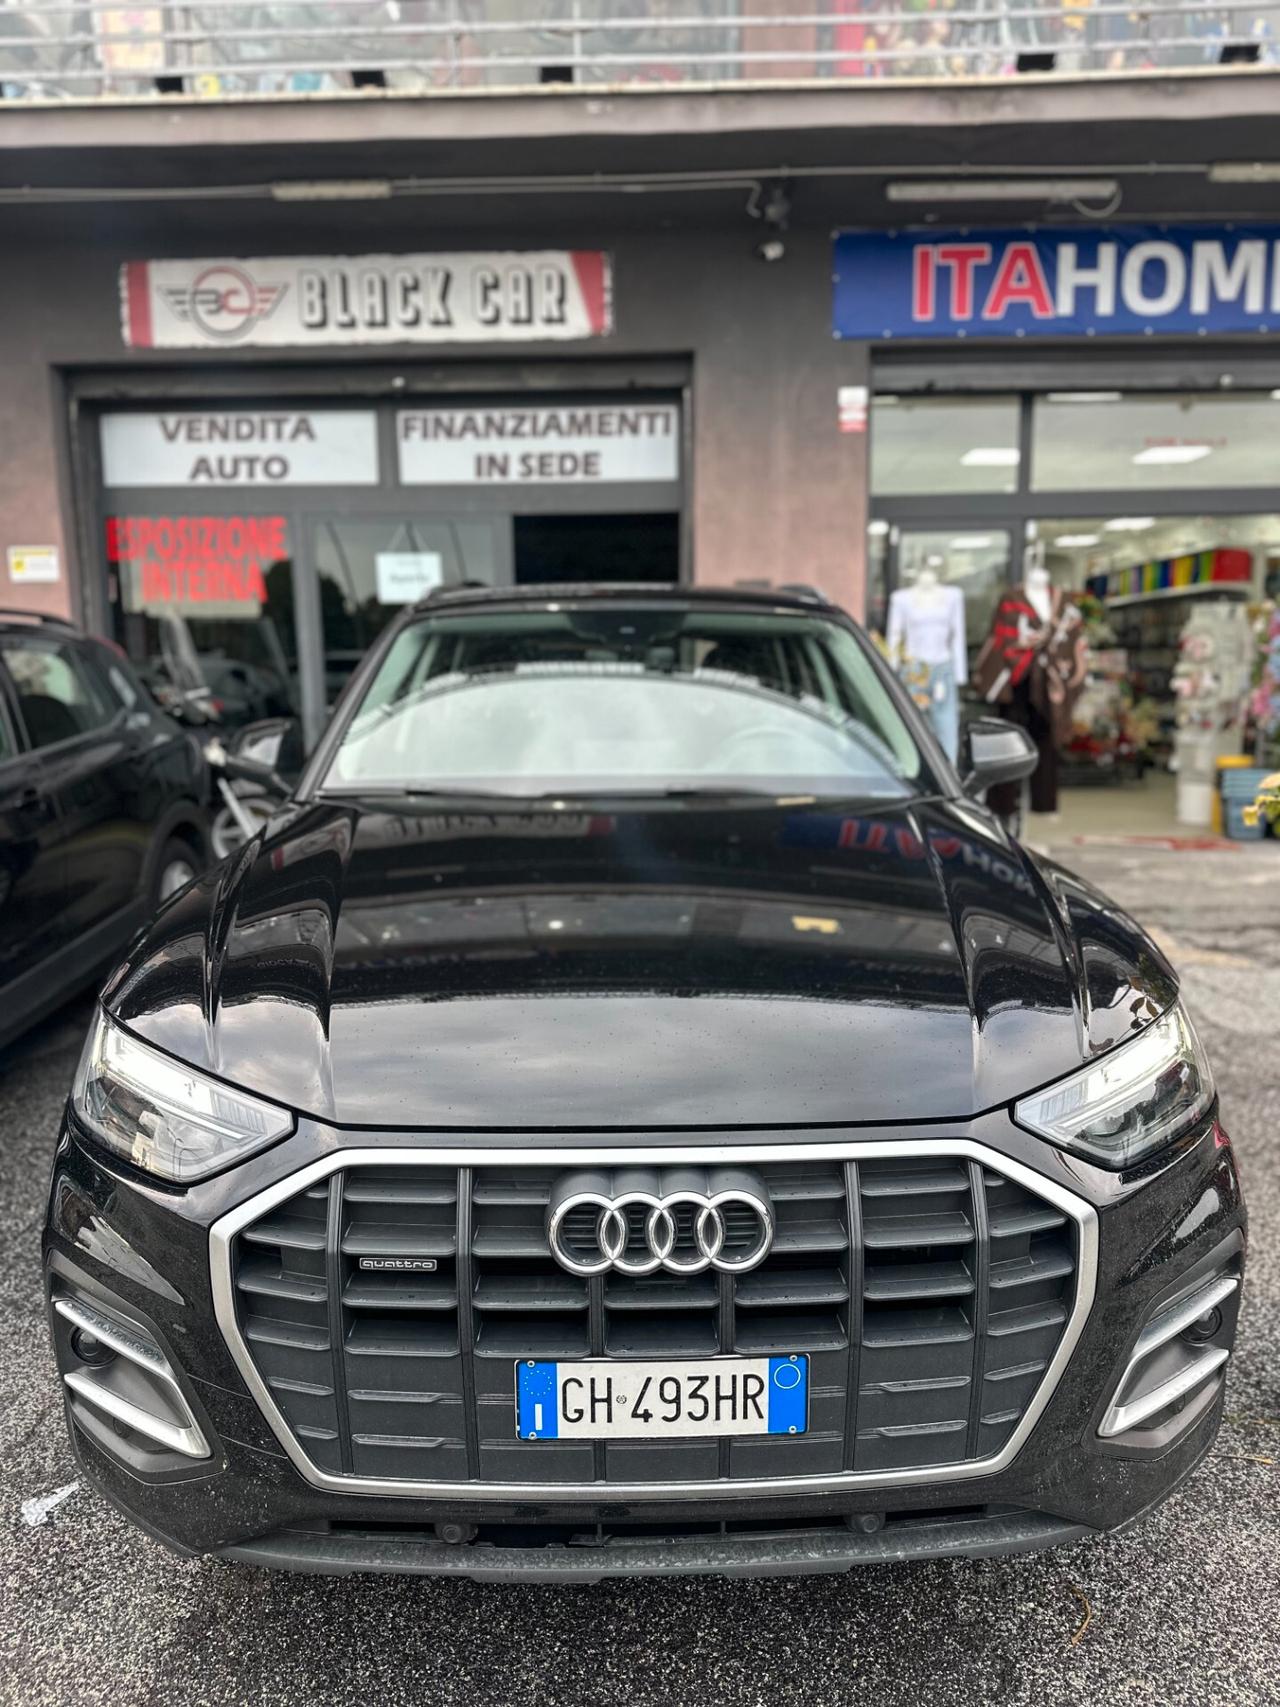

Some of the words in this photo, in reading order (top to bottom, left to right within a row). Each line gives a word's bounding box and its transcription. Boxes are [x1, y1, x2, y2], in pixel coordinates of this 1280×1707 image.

[912, 240, 1280, 322] ITAHOM
[299, 267, 453, 331] BLACK
[471, 263, 567, 327] CAR
[159, 416, 315, 443] VENDITA
[402, 411, 671, 440] FINANZIAMENTI
[189, 456, 290, 480] AUTO
[475, 454, 509, 477] IN
[518, 452, 600, 477] SEDE
[106, 516, 288, 561] ESPOSIZIONE
[142, 561, 268, 603] INTERNA
[362, 1260, 433, 1269] quattro
